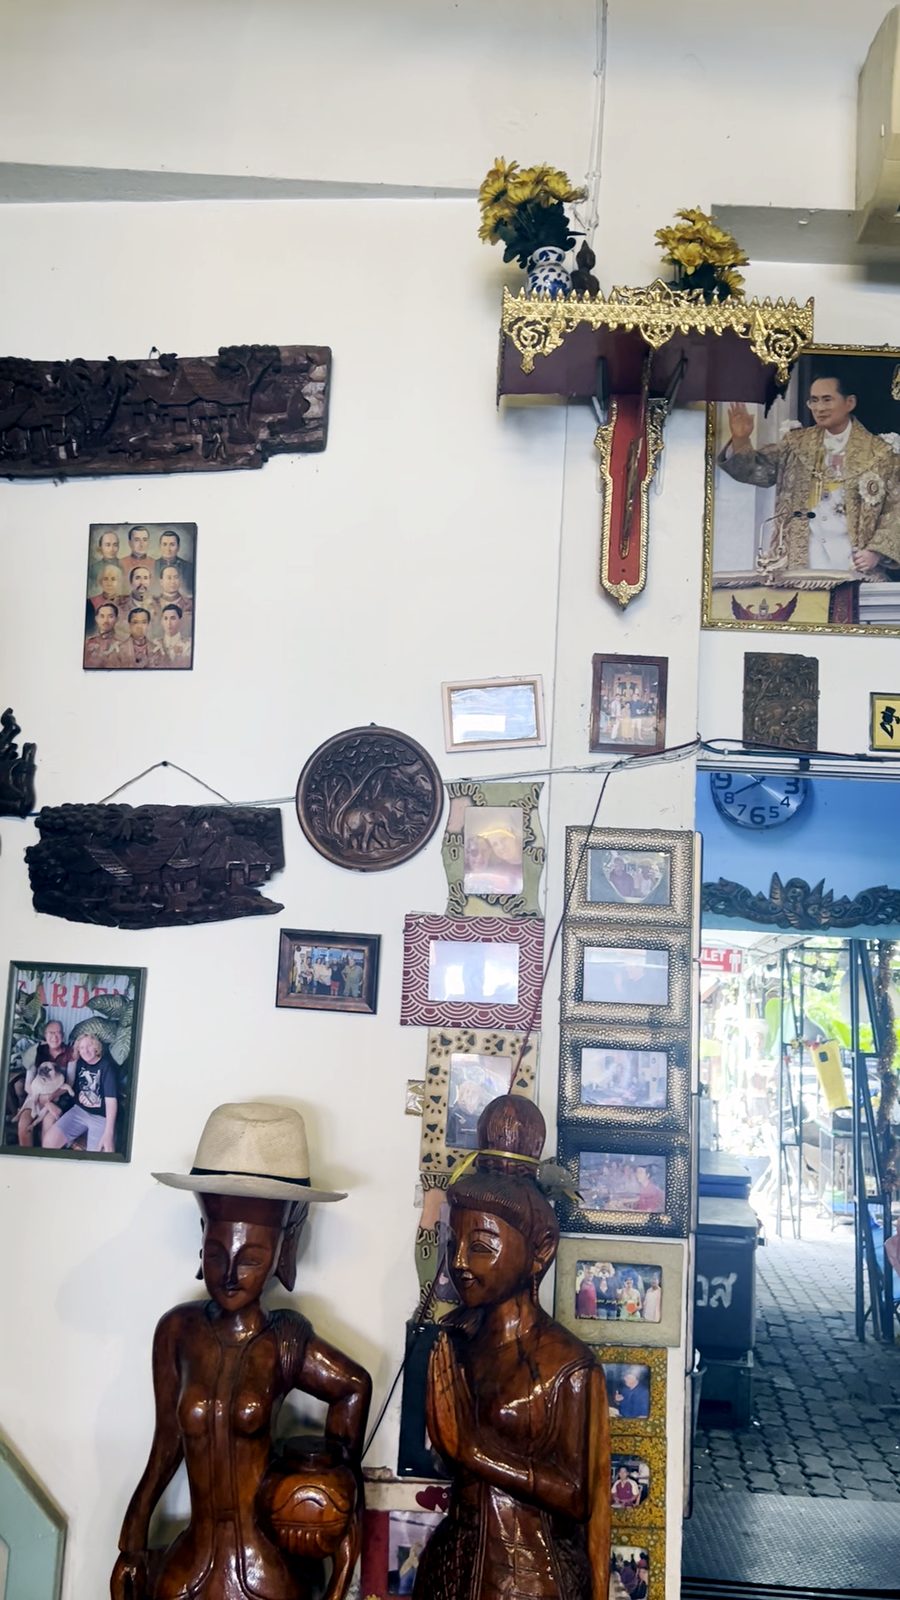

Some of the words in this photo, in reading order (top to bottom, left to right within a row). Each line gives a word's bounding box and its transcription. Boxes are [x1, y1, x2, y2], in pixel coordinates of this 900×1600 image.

[723, 791, 735, 804] 8
[780, 795, 791, 808] 4
[736, 803, 747, 816] 7
[749, 806, 766, 825] 6
[769, 805, 780, 818] 5
